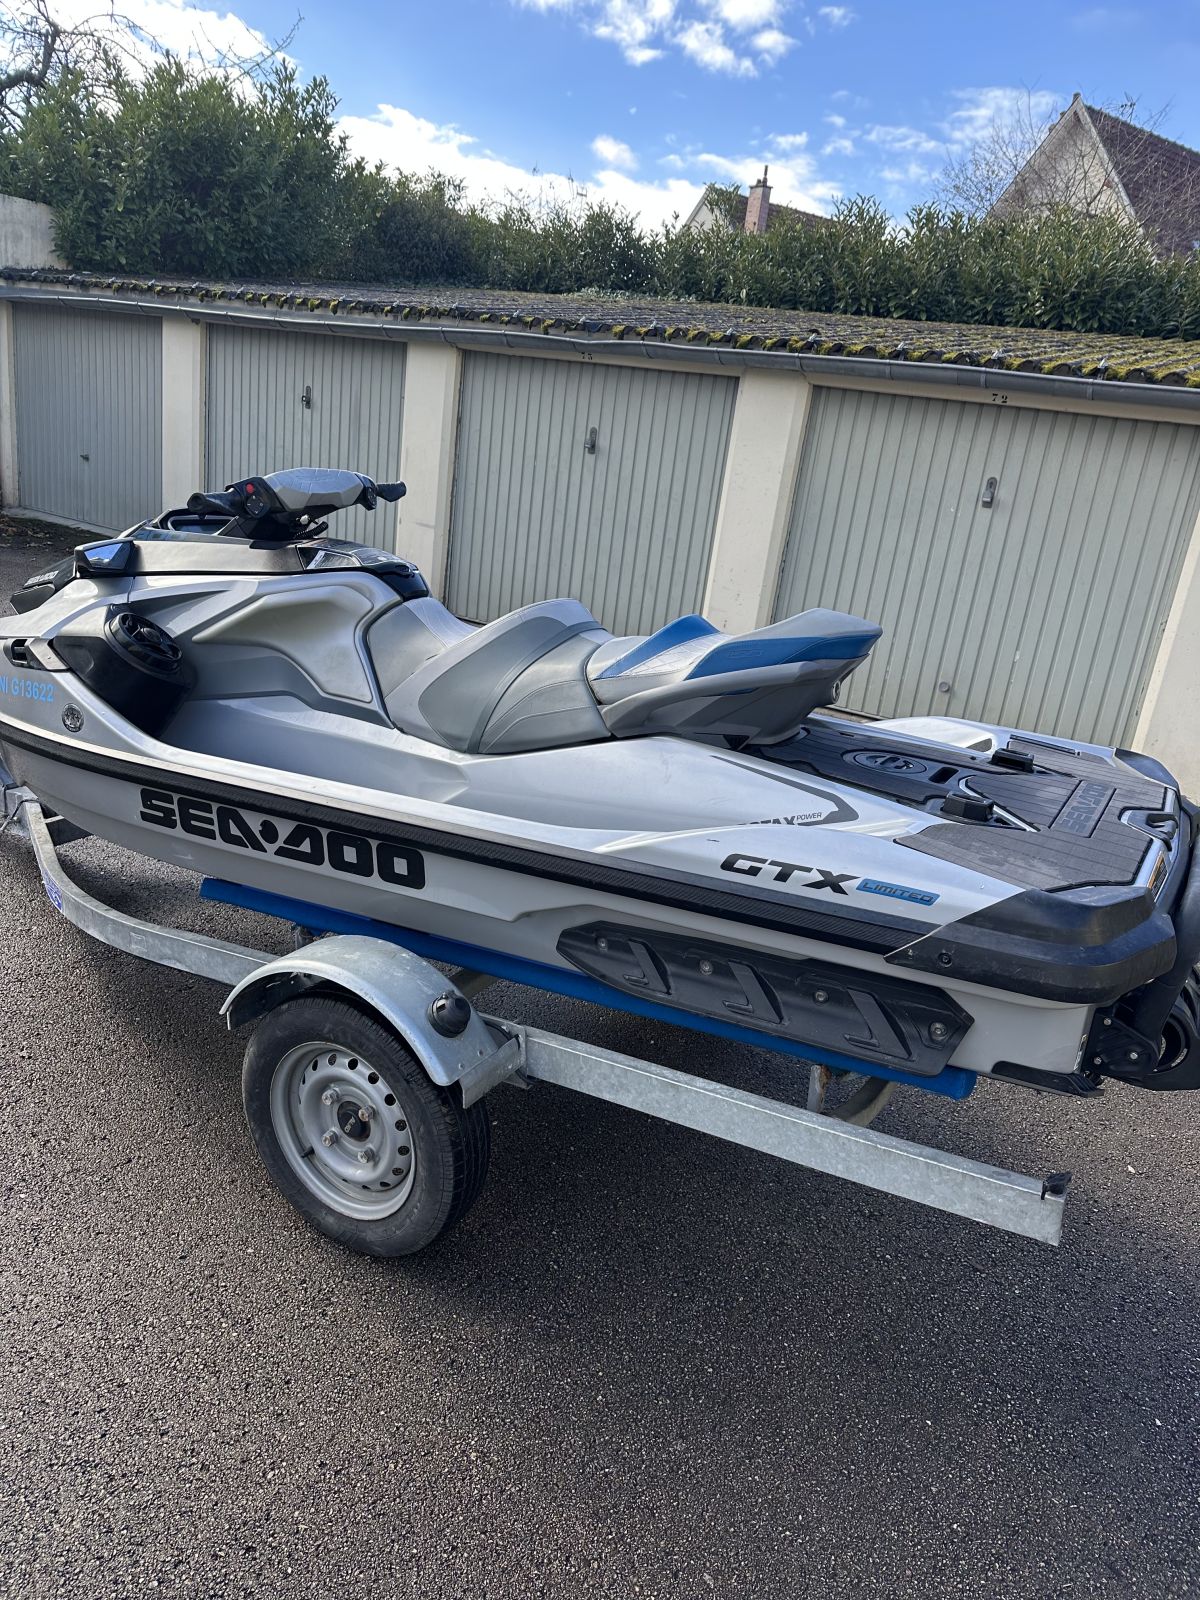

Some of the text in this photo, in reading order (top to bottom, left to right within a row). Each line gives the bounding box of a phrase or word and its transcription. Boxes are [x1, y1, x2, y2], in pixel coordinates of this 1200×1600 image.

[992, 393, 1008, 404] 72
[11, 678, 54, 702] G13622
[796, 811, 823, 821] POWER
[719, 853, 935, 904] GTX LIMITED
